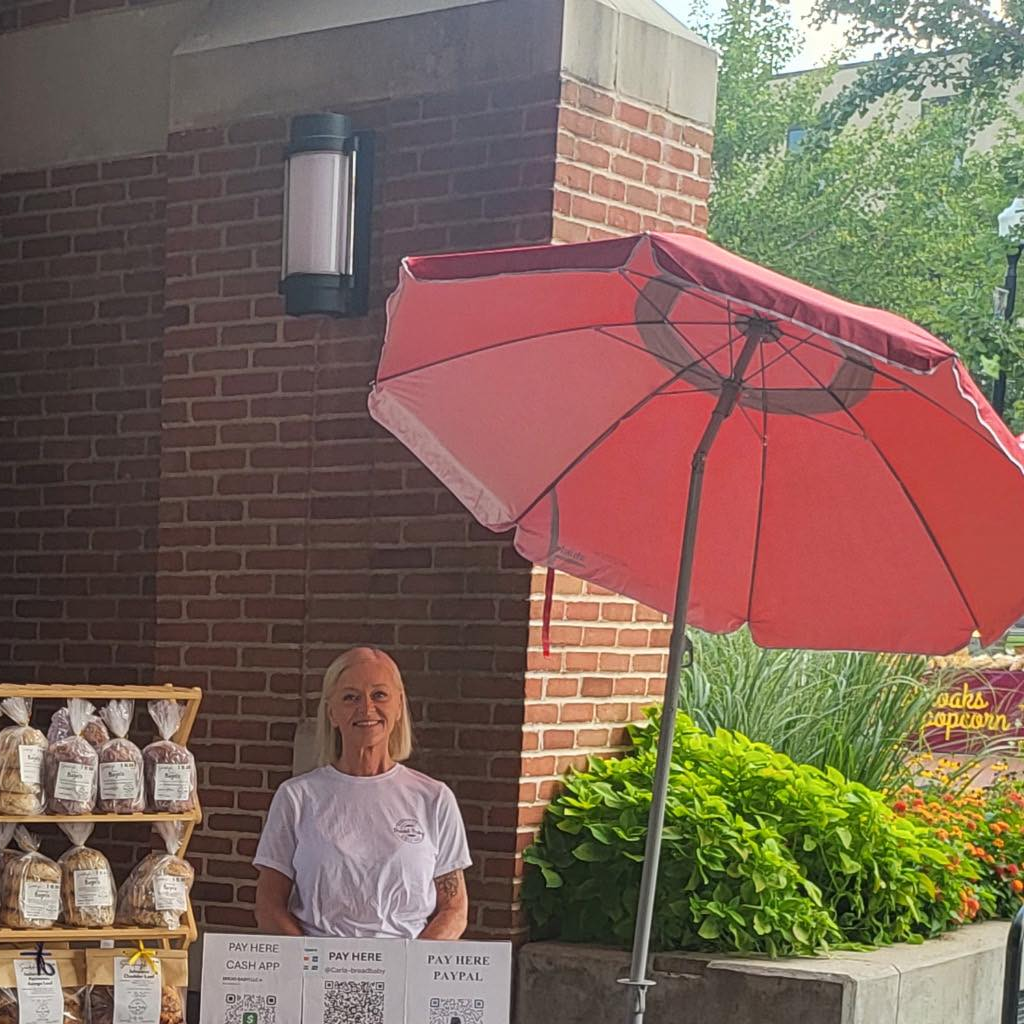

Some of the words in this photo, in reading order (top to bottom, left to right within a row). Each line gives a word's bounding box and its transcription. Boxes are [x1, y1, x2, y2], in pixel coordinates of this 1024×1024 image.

[932, 682, 990, 710] oaks
[228, 942, 249, 952] PAY
[250, 943, 280, 954] HERE
[328, 952, 349, 962] PAY
[351, 952, 382, 962] HERE
[427, 955, 453, 965] PAY
[455, 955, 490, 966] HERE
[226, 960, 256, 970] CASH
[258, 961, 280, 971] APP
[433, 971, 483, 982] PAYPAL
